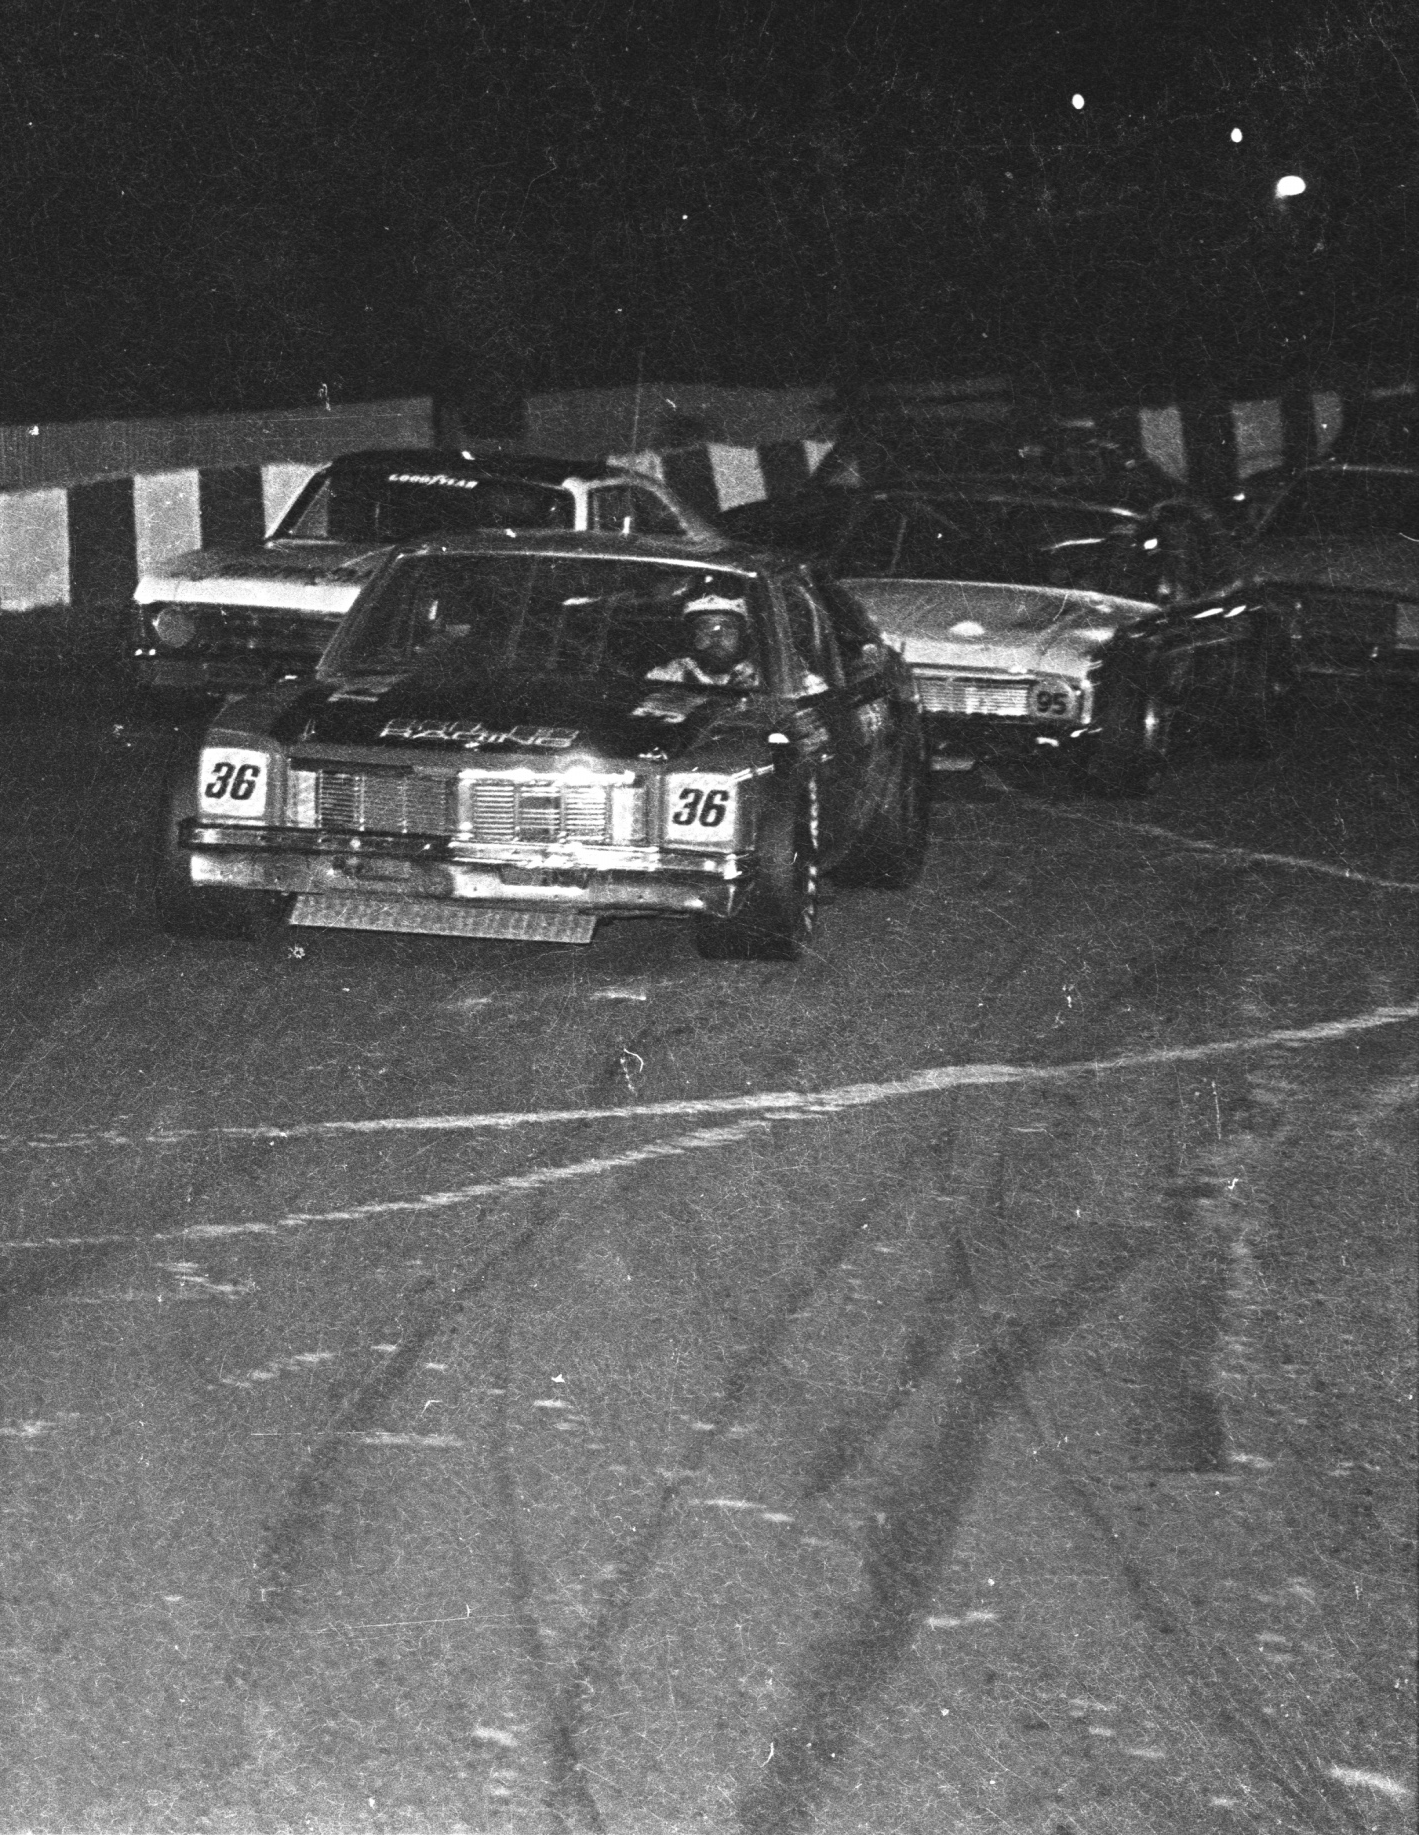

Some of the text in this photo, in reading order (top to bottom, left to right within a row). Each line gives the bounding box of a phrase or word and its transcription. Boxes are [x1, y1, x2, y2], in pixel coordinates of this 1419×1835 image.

[1037, 691, 1068, 715] 95
[205, 762, 260, 800] 36
[672, 788, 729, 827] 36
